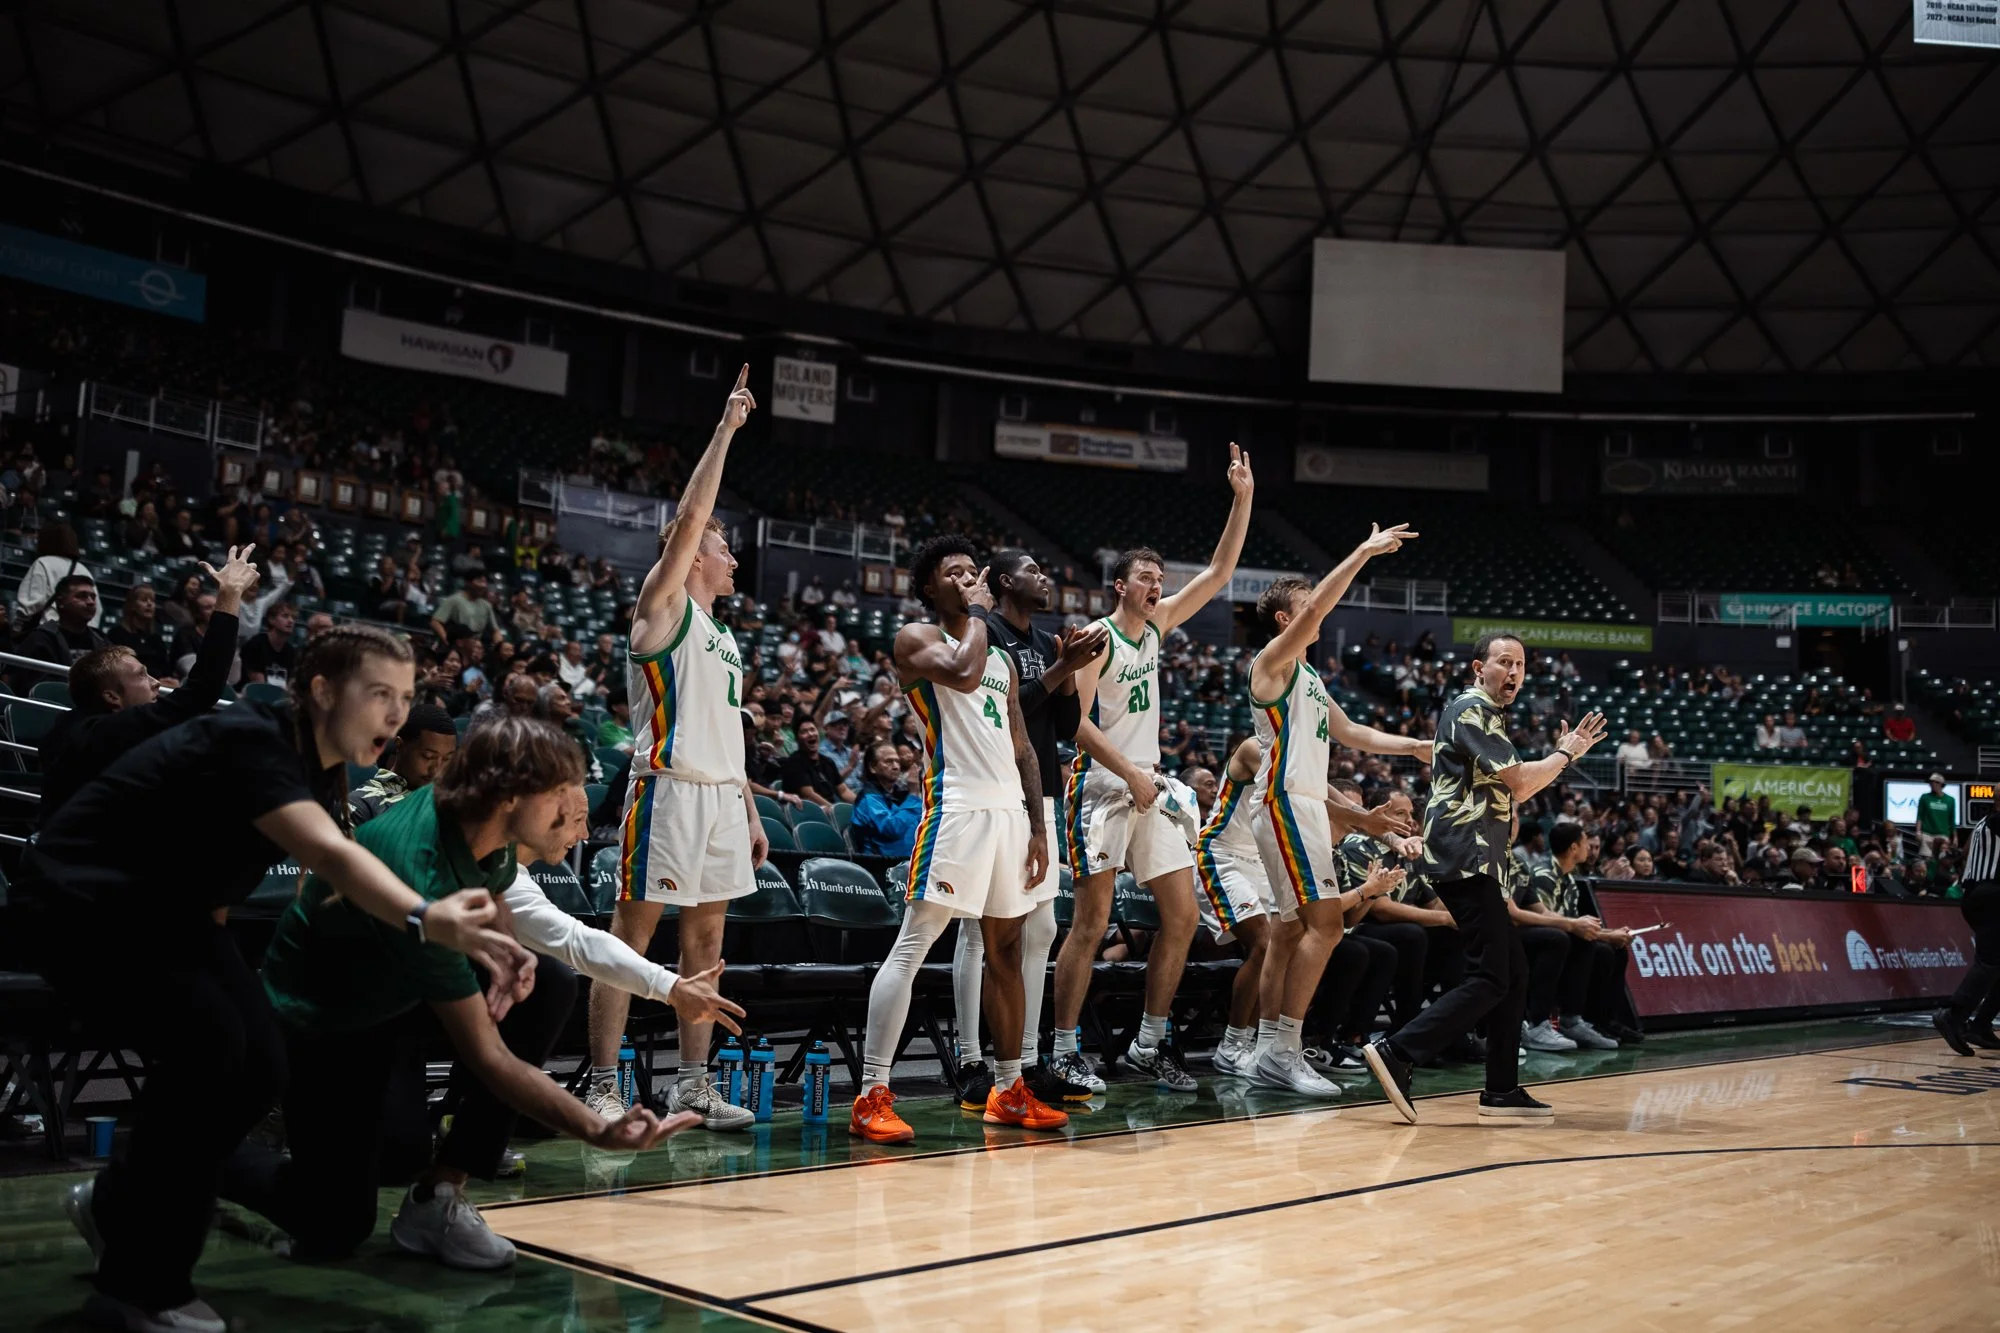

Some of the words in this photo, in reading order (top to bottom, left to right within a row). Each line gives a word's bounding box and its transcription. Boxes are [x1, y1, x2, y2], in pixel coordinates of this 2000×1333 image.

[1926, 13, 1942, 21] 2022
[1947, 14, 1964, 23] NCAA
[1976, 16, 1997, 25] Round
[1947, 3, 1964, 11] NCAA
[1976, 5, 1998, 13] Round
[779, 363, 831, 386] ISLAND
[774, 383, 834, 406] MOVERS
[1736, 463, 1797, 479] RANCH
[1817, 602, 1885, 617] FACTORS
[1551, 629, 1605, 643] SAVINGS
[1607, 631, 1646, 646] BANK
[1128, 679, 1150, 714] 20
[983, 694, 1003, 729] 4
[1751, 780, 1841, 798] AMERICAN
[820, 882, 844, 893] Bank
[845, 884, 854, 894] of
[1131, 891, 1148, 901] Bank
[1631, 932, 1704, 977] Bank
[1701, 943, 1736, 976] on
[1732, 932, 1776, 974] the
[1772, 933, 1828, 973] best.
[1876, 947, 1903, 969] First
[1900, 947, 1944, 969] Hawaiian
[623, 1061, 632, 1111] OWERADE
[723, 1061, 731, 1104] OWERADE
[751, 1063, 760, 1112] POWERADE
[814, 1065, 823, 1113] POWERADE
